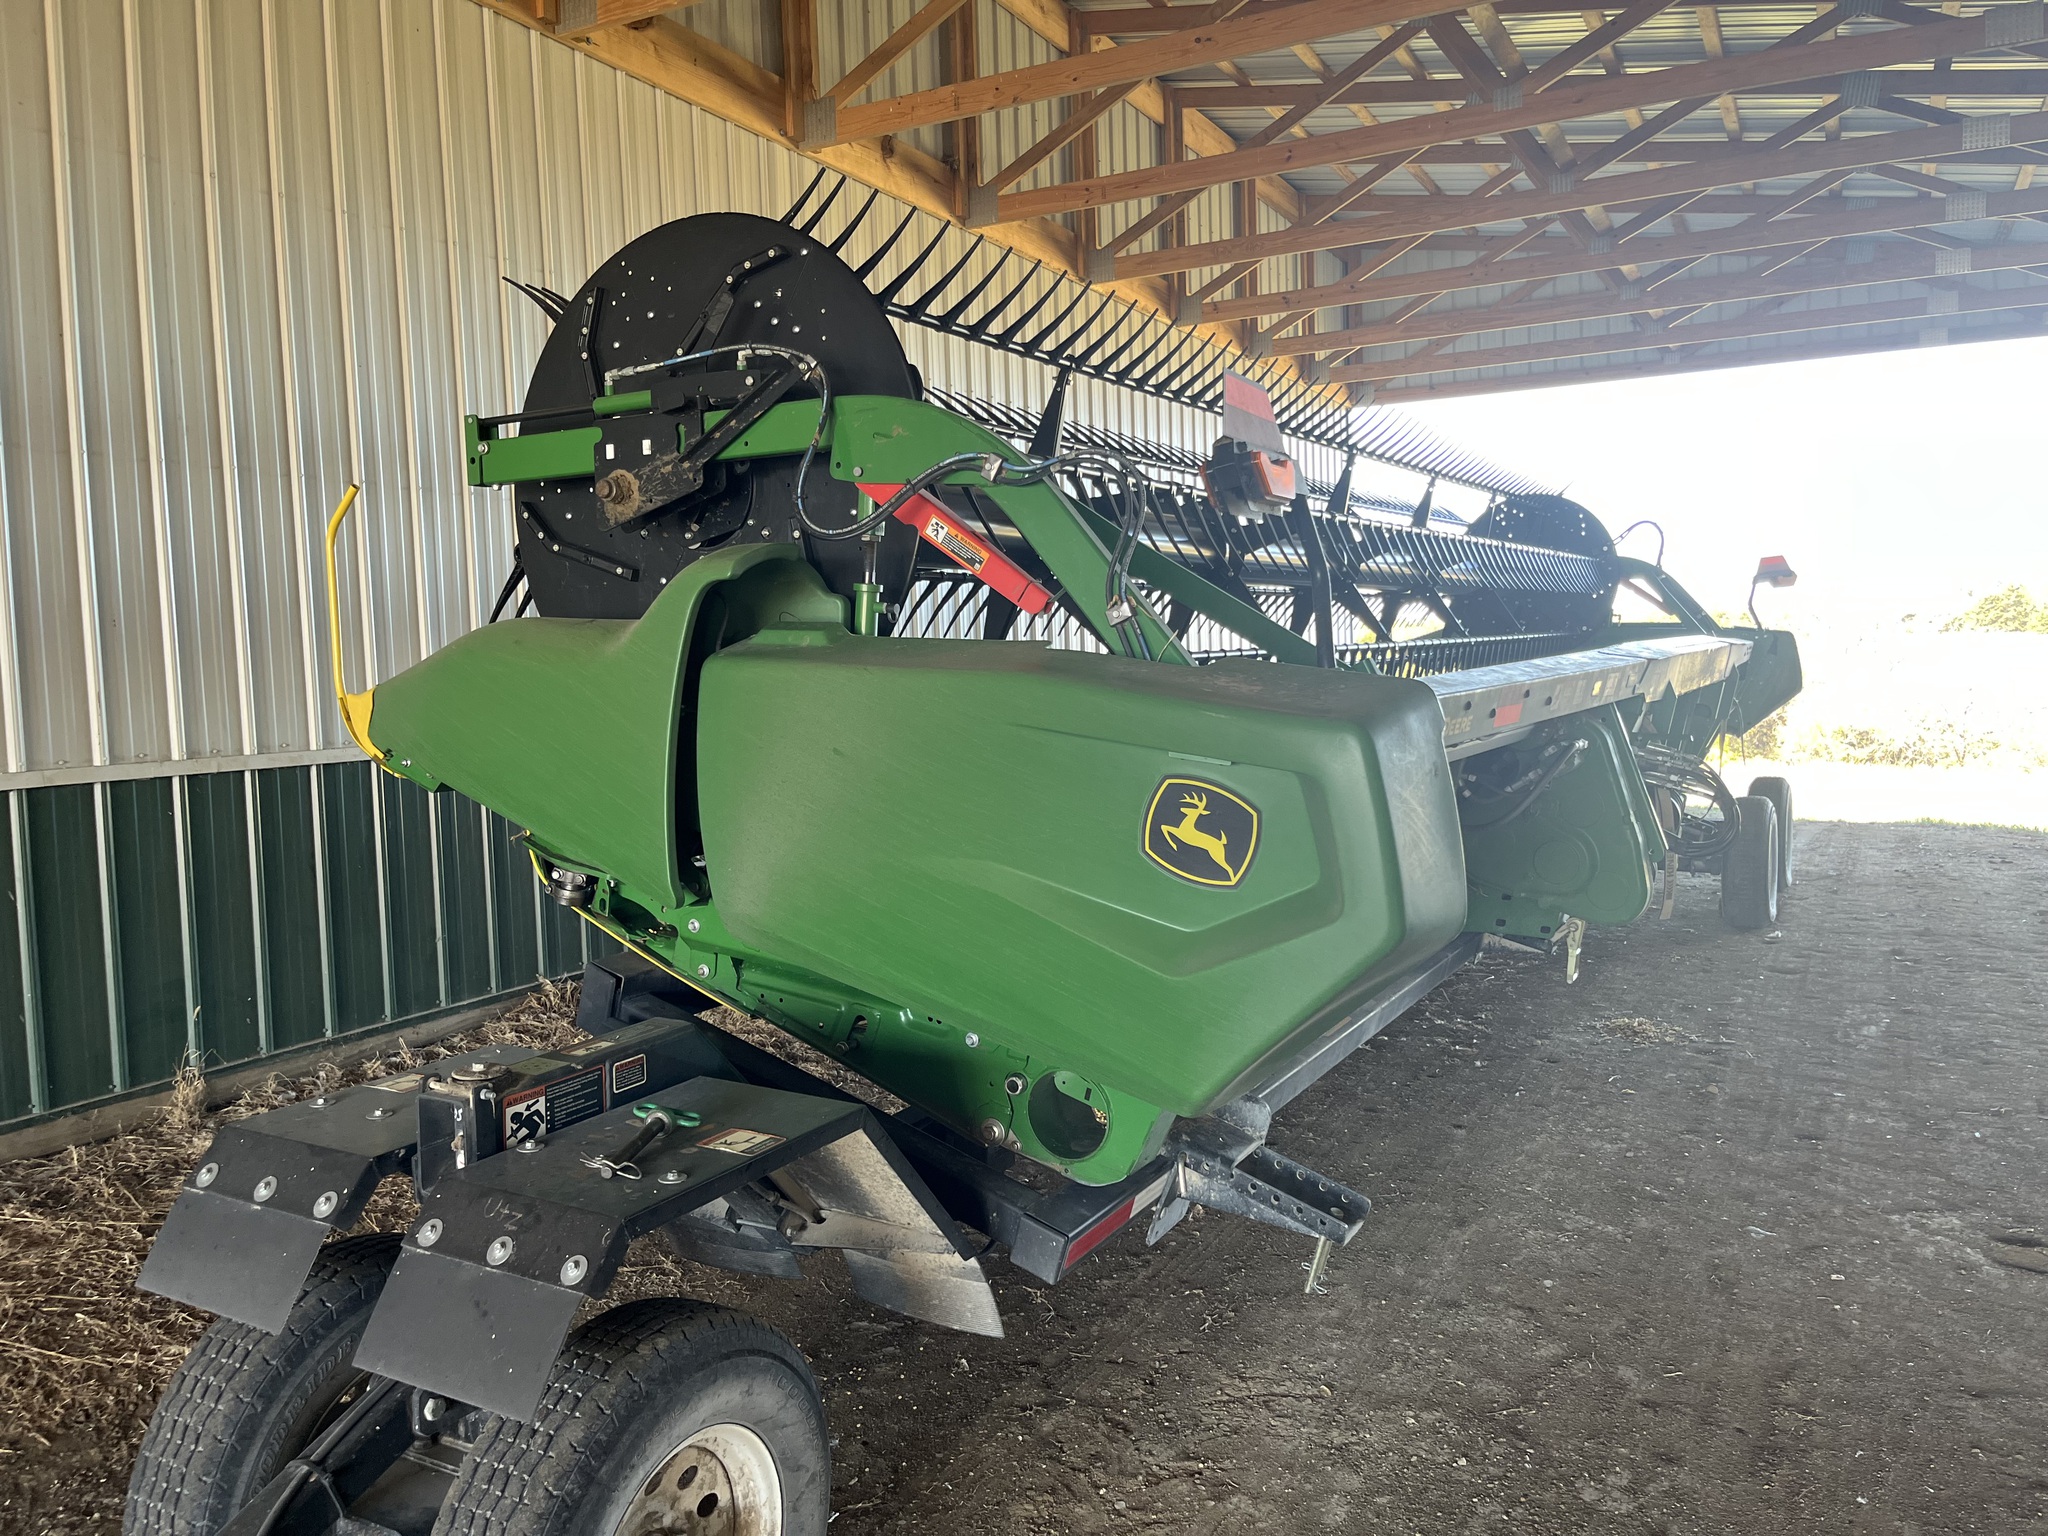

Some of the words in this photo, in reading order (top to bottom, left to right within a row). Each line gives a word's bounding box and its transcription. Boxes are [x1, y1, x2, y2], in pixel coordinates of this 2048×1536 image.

[960, 536, 983, 555] WARNING
[1445, 715, 1473, 736] DEERE
[512, 1088, 544, 1104] WARNING
[250, 1334, 353, 1499] OODRIDE
